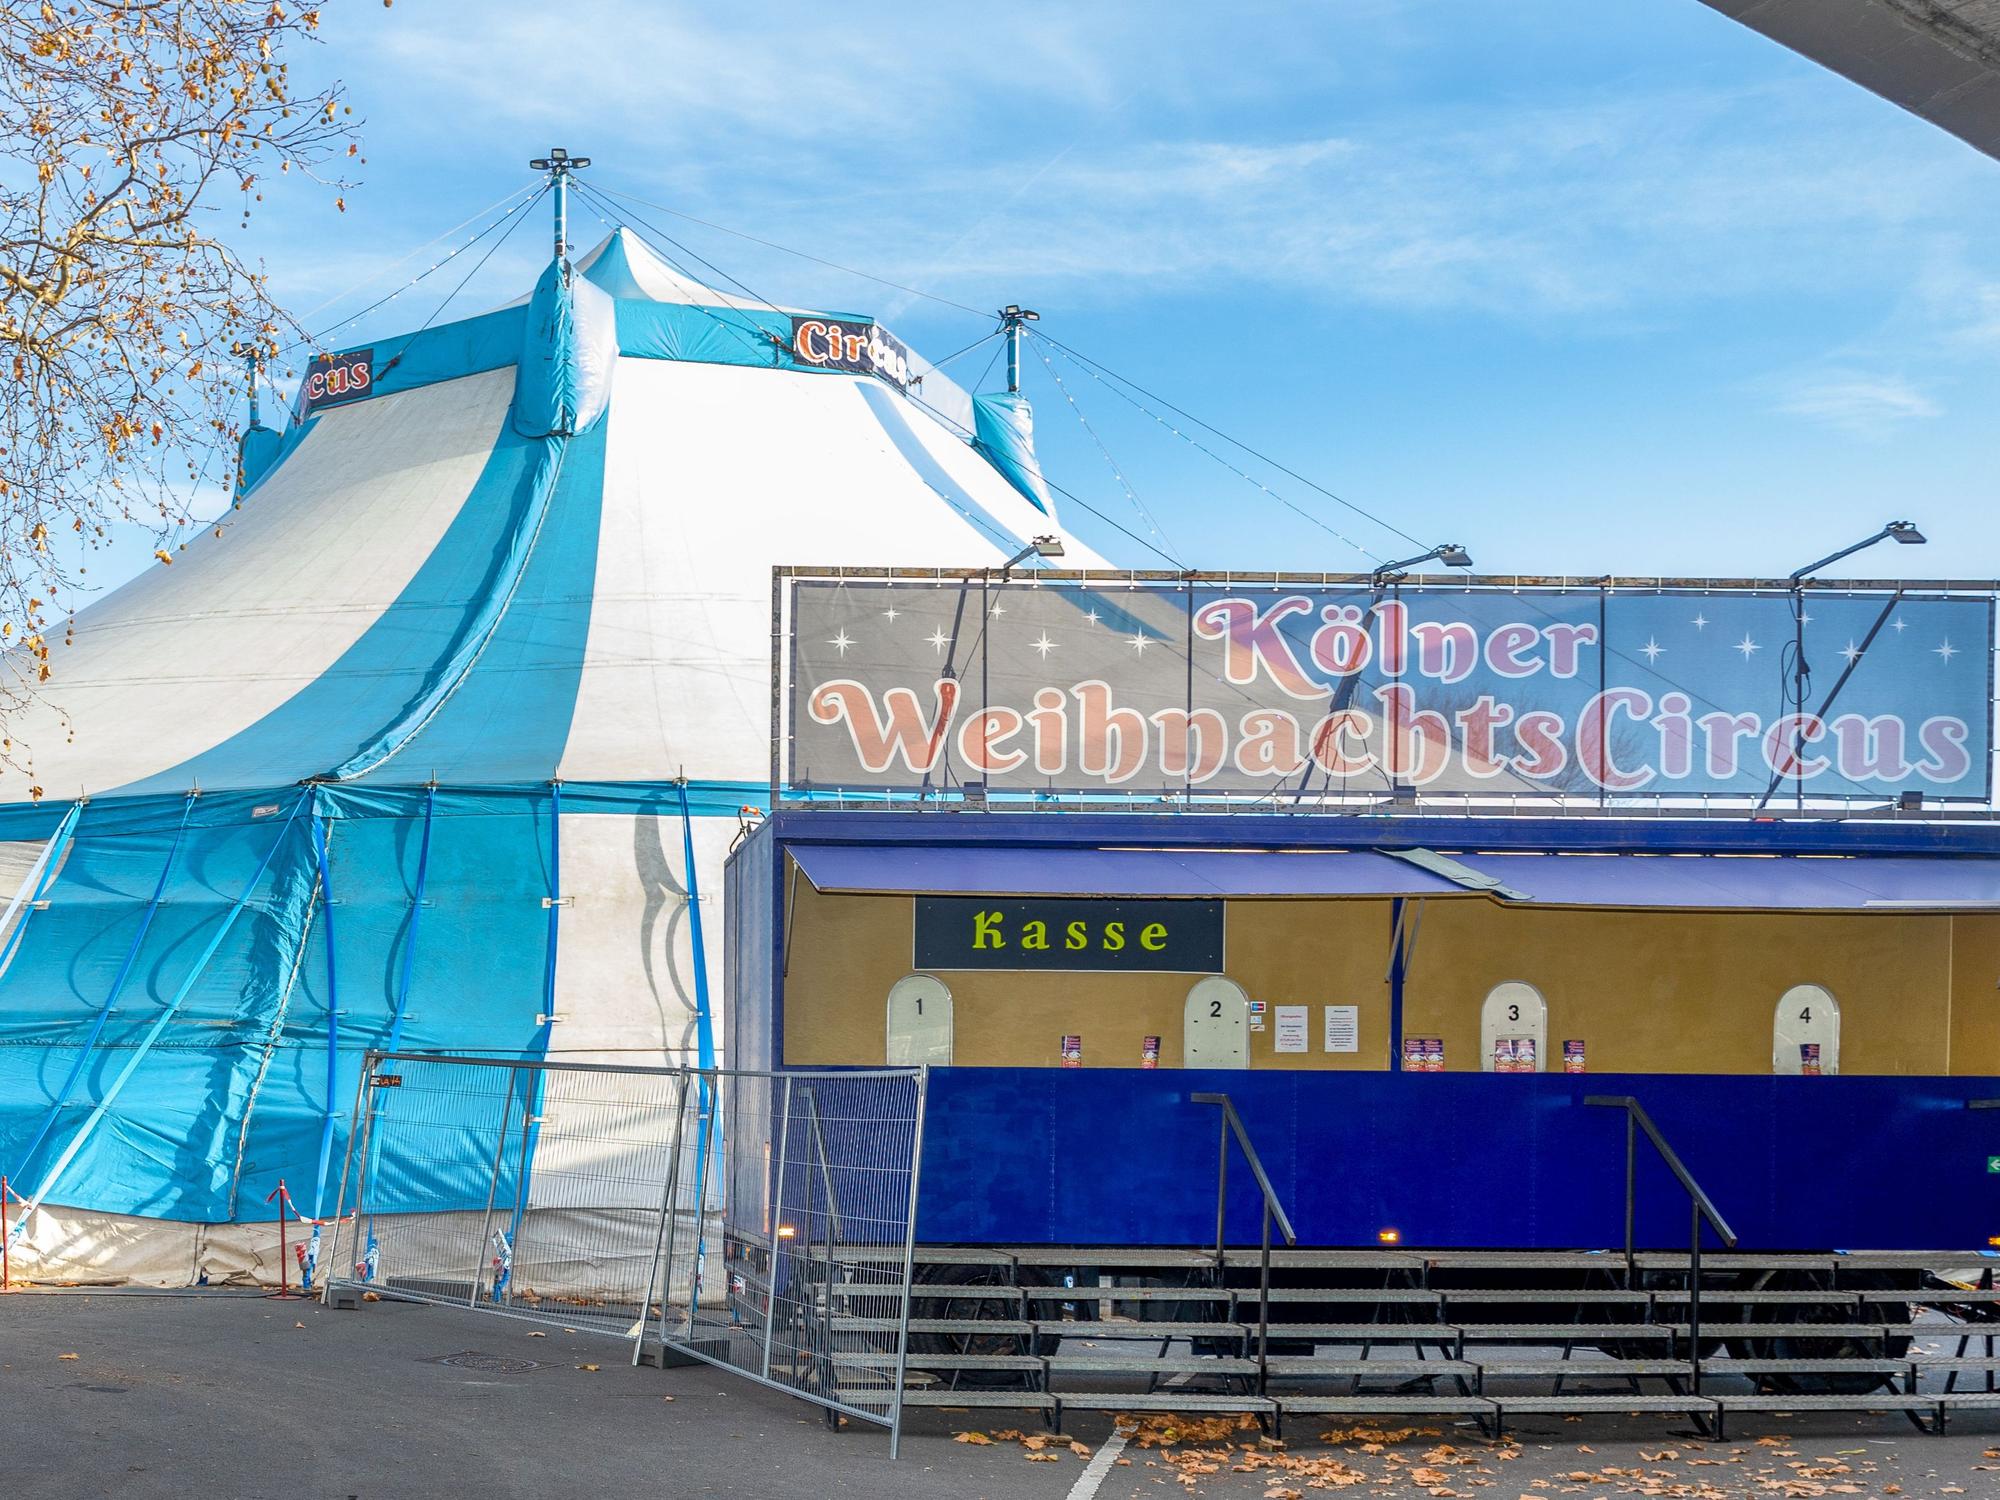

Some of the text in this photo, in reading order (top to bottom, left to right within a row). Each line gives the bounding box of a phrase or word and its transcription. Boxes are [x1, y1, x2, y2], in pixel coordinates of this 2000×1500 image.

[797, 321, 907, 385] Circus
[1193, 596, 1598, 700] Kölner
[972, 911, 1169, 951] Kasse
[915, 998, 924, 1016] 1
[1210, 1001, 1222, 1018] 2
[1508, 1004, 1520, 1022] 3
[1799, 1007, 1812, 1024] 4
